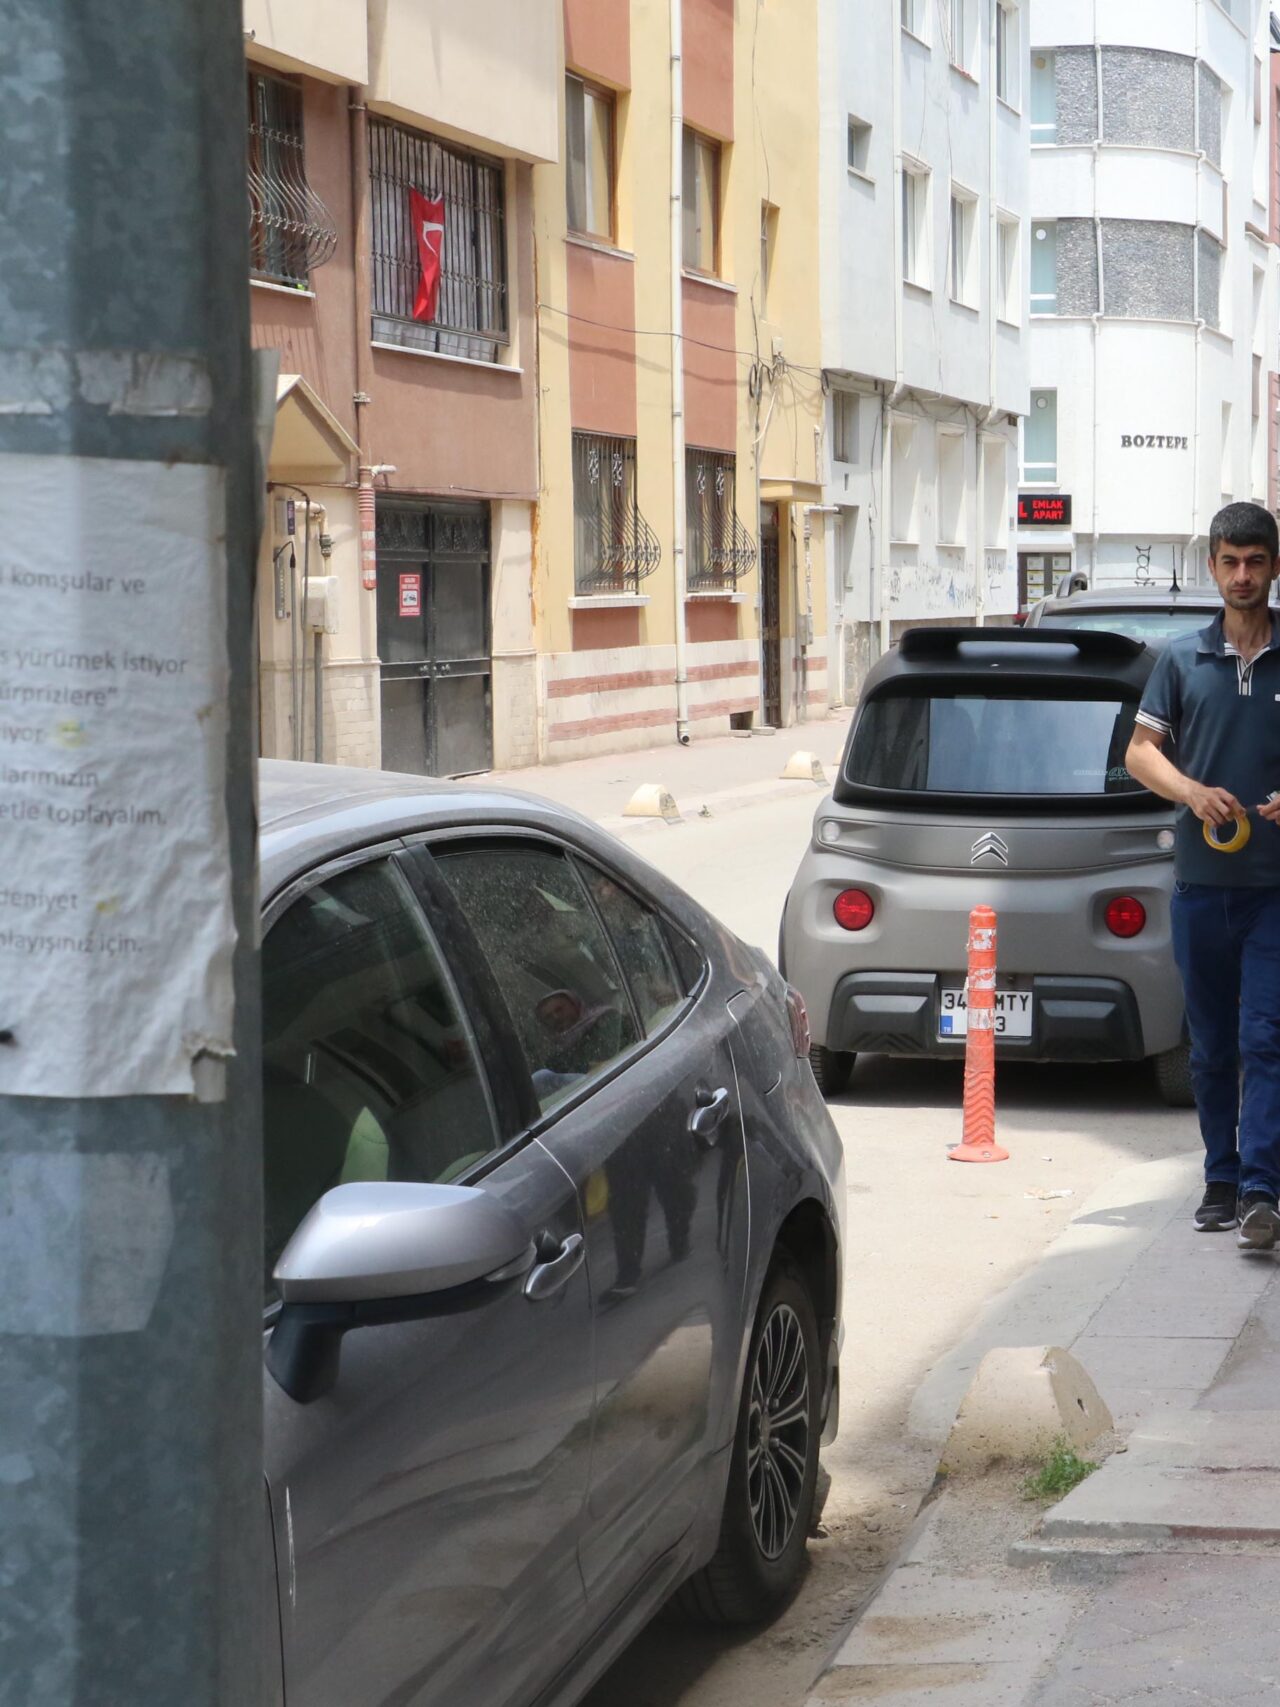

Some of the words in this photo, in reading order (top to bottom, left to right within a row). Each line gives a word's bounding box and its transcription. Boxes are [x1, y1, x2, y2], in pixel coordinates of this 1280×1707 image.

[1121, 434, 1188, 450] BOZTEPE
[1032, 500, 1064, 509] EMLAK
[1032, 510, 1064, 520] APART
[11, 564, 115, 593] komşular
[121, 577, 146, 594] ve
[16, 648, 117, 670] yürümek
[122, 651, 188, 677] istiyor
[100, 933, 143, 956] için.
[944, 993, 967, 1010] 34
[994, 994, 1029, 1012] MTY
